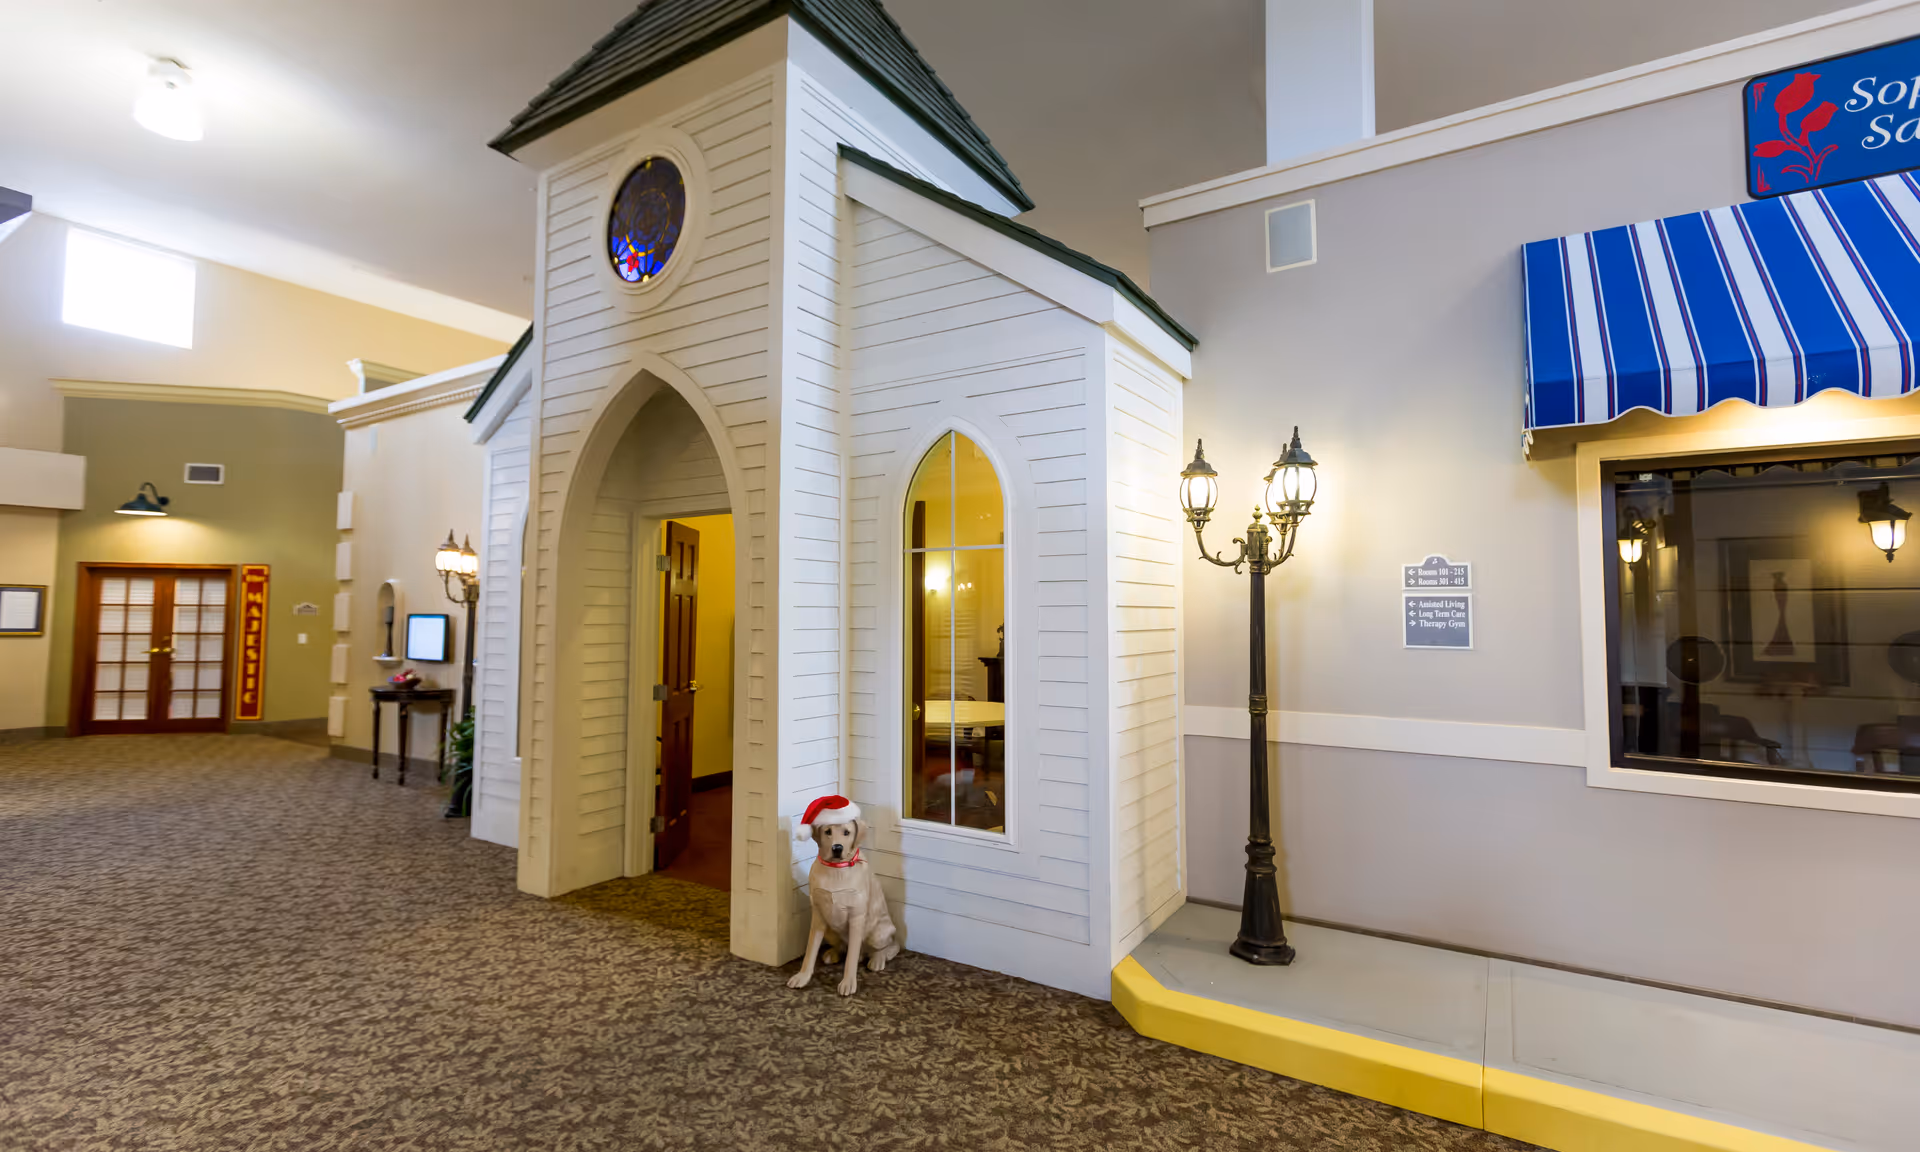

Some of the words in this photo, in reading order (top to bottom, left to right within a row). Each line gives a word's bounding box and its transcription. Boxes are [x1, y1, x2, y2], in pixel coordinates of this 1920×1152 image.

[1439, 568, 1448, 576] 101
[1454, 568, 1464, 576] 215
[1454, 577, 1464, 585] 415
[1419, 600, 1443, 608] Assisted
[1445, 600, 1465, 609] Living
[1419, 610, 1433, 619] Long
[1419, 620, 1447, 629] Therapy
[1448, 620, 1466, 628] Gym
[244, 592, 262, 704] MAJESTIC
